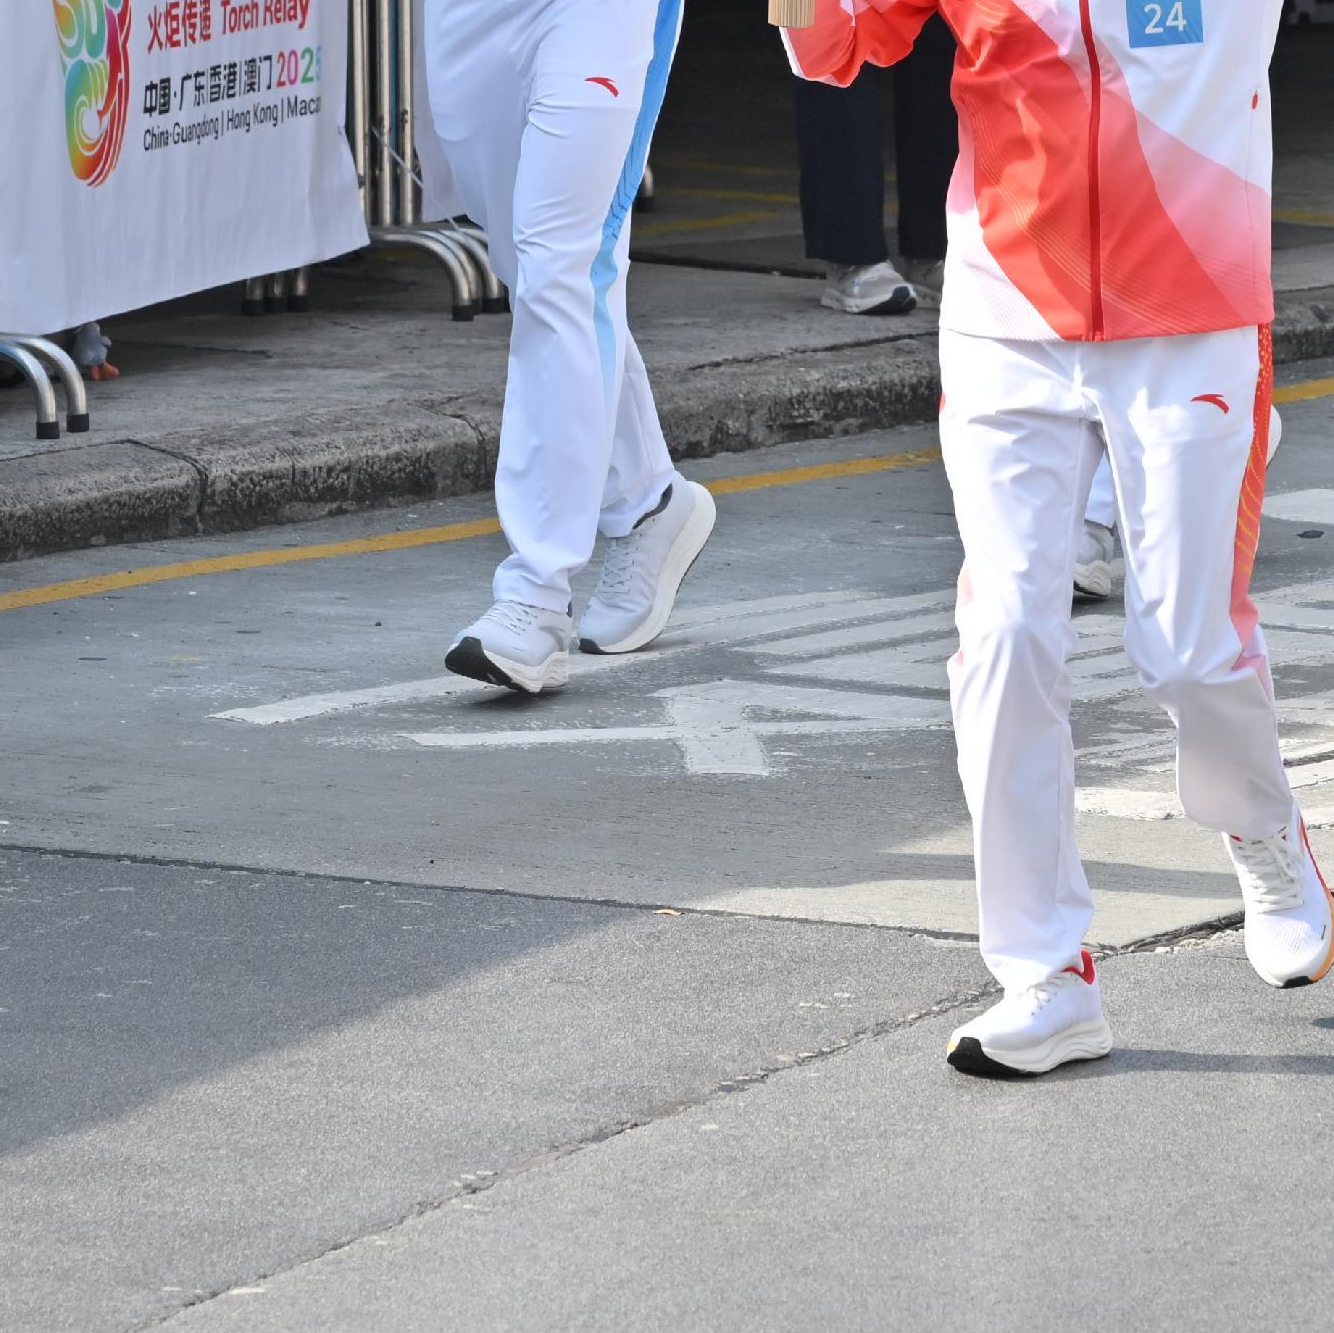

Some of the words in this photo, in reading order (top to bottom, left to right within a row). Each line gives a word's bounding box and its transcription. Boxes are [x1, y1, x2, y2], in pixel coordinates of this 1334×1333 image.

[1143, 1, 1187, 34] 24
[227, 108, 250, 133] Hong
[253, 102, 278, 127] Kong
